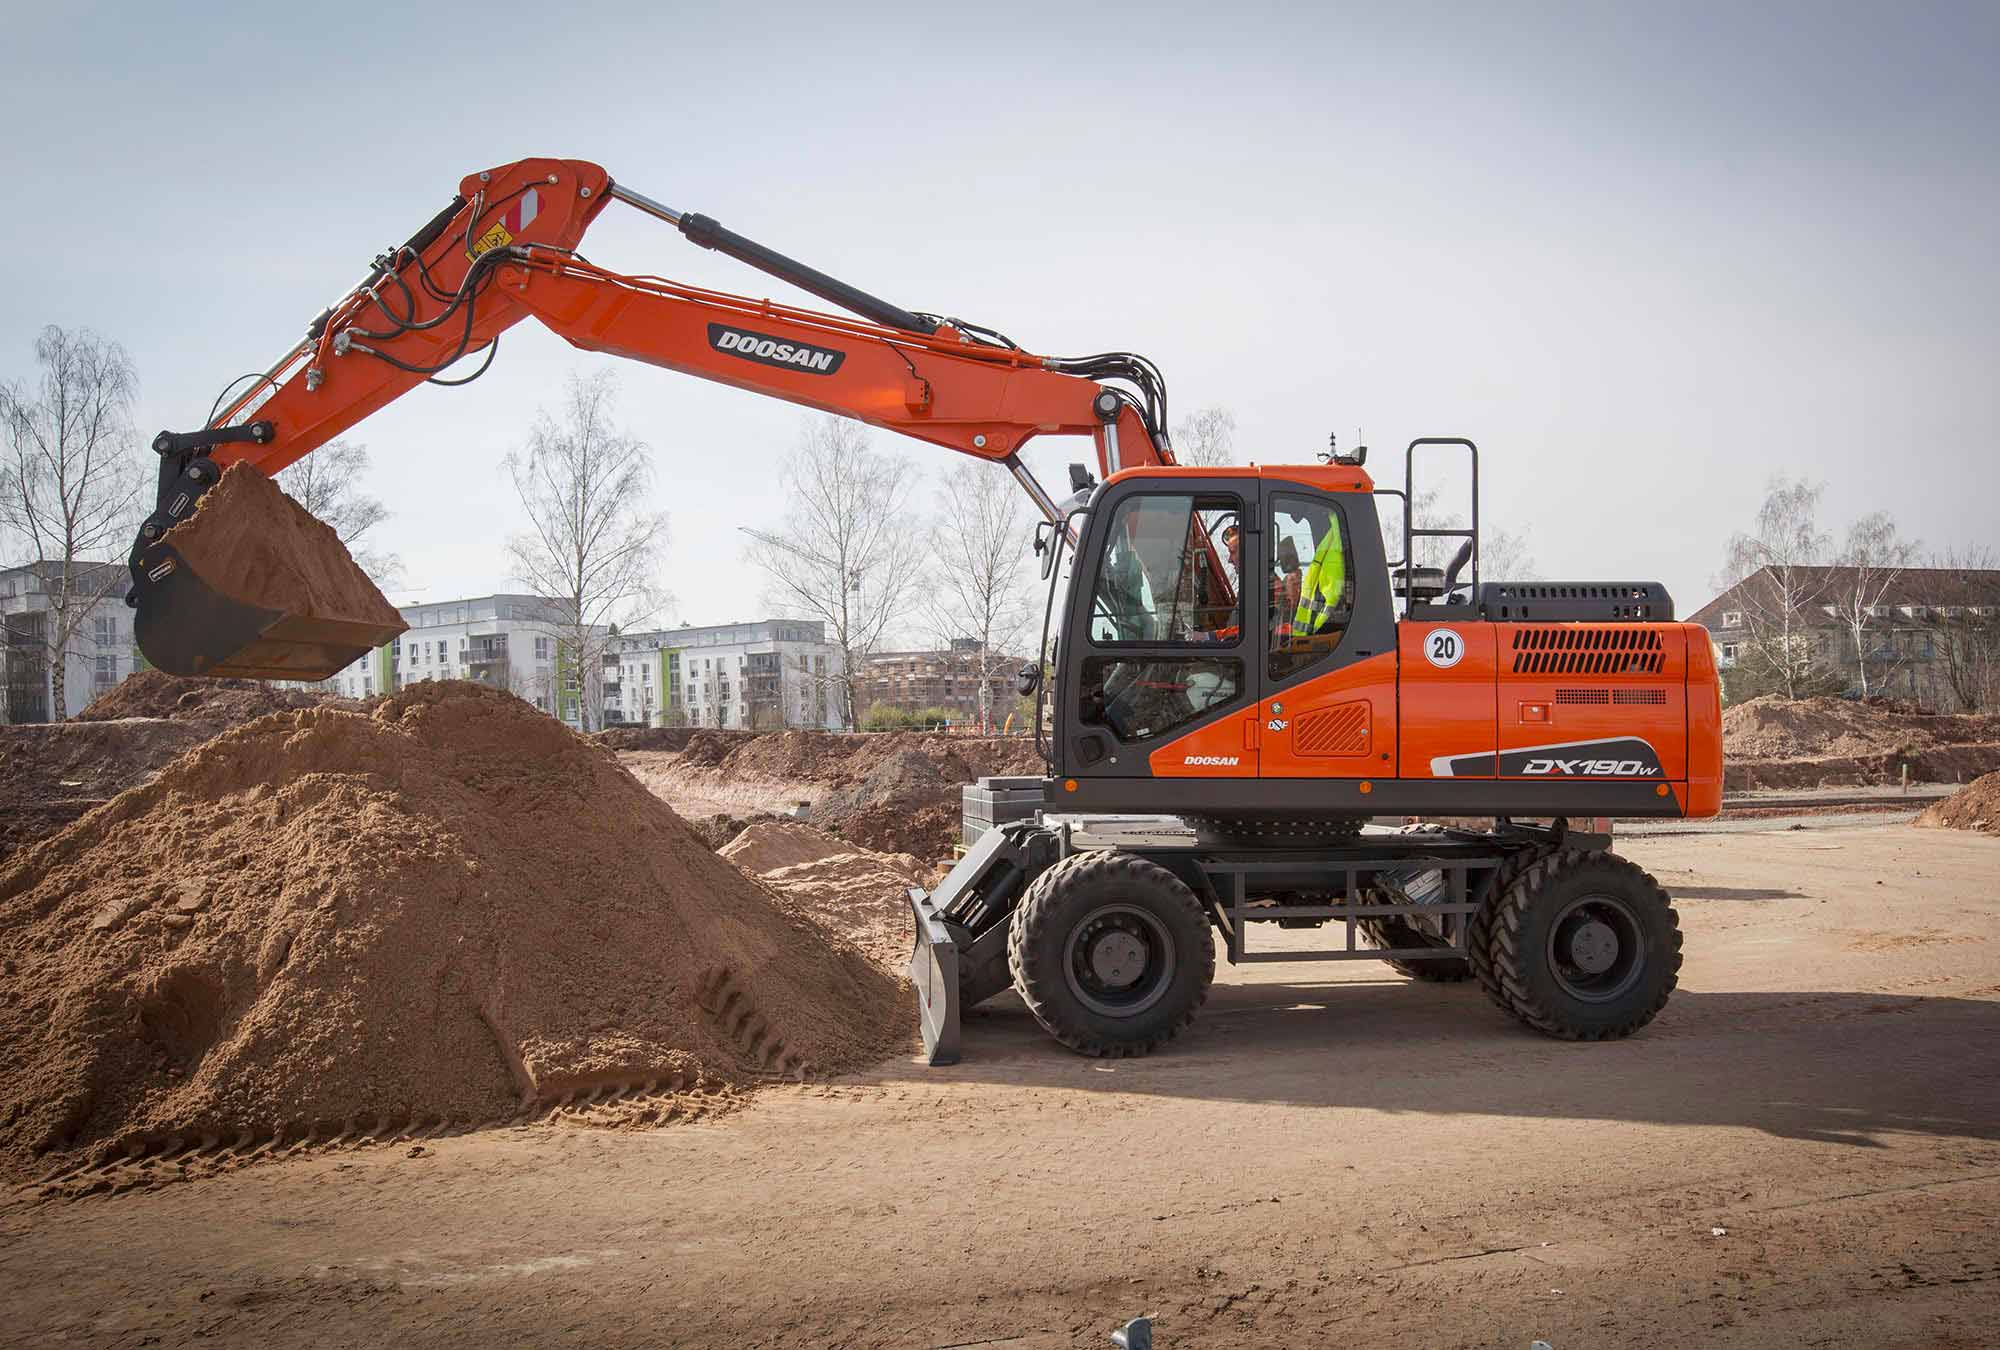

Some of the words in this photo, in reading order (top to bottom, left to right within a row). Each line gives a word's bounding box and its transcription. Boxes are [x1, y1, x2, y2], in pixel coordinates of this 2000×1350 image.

[717, 331, 834, 370] DOOSAN
[1434, 636, 1455, 659] 20
[1184, 756, 1240, 766] DOOSAN
